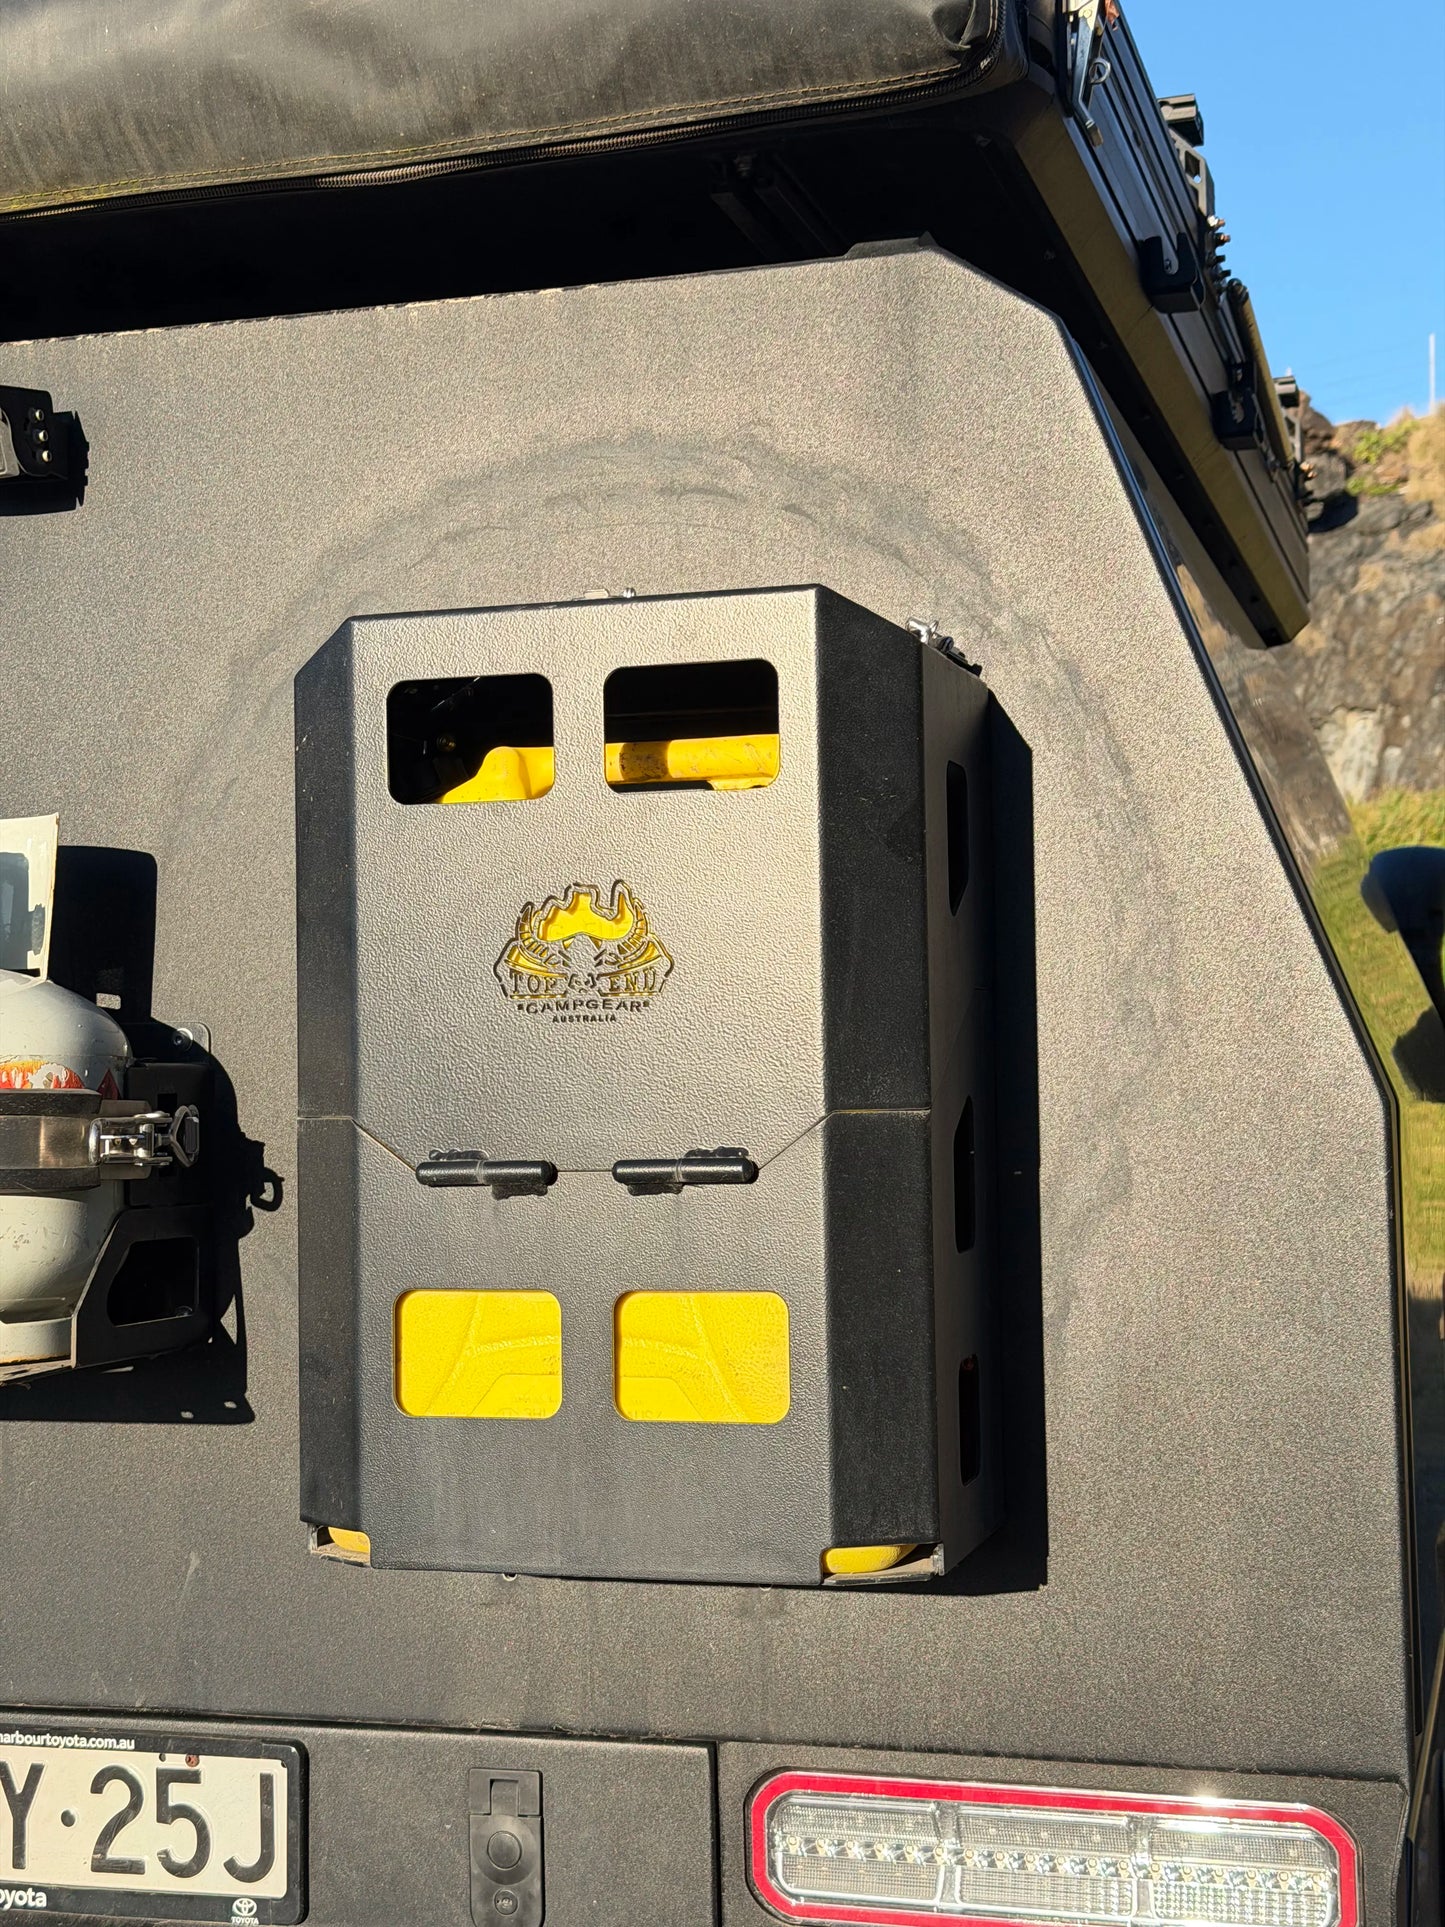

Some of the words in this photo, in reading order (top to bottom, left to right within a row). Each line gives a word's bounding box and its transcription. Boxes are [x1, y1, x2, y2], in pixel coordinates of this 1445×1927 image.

[509, 970, 557, 994] TOP
[609, 967, 656, 992] END
[526, 999, 643, 1014] CAMPGEAR
[552, 1015, 617, 1023] AUSTRALIA
[230, 1916, 260, 1925] TOYOTA
